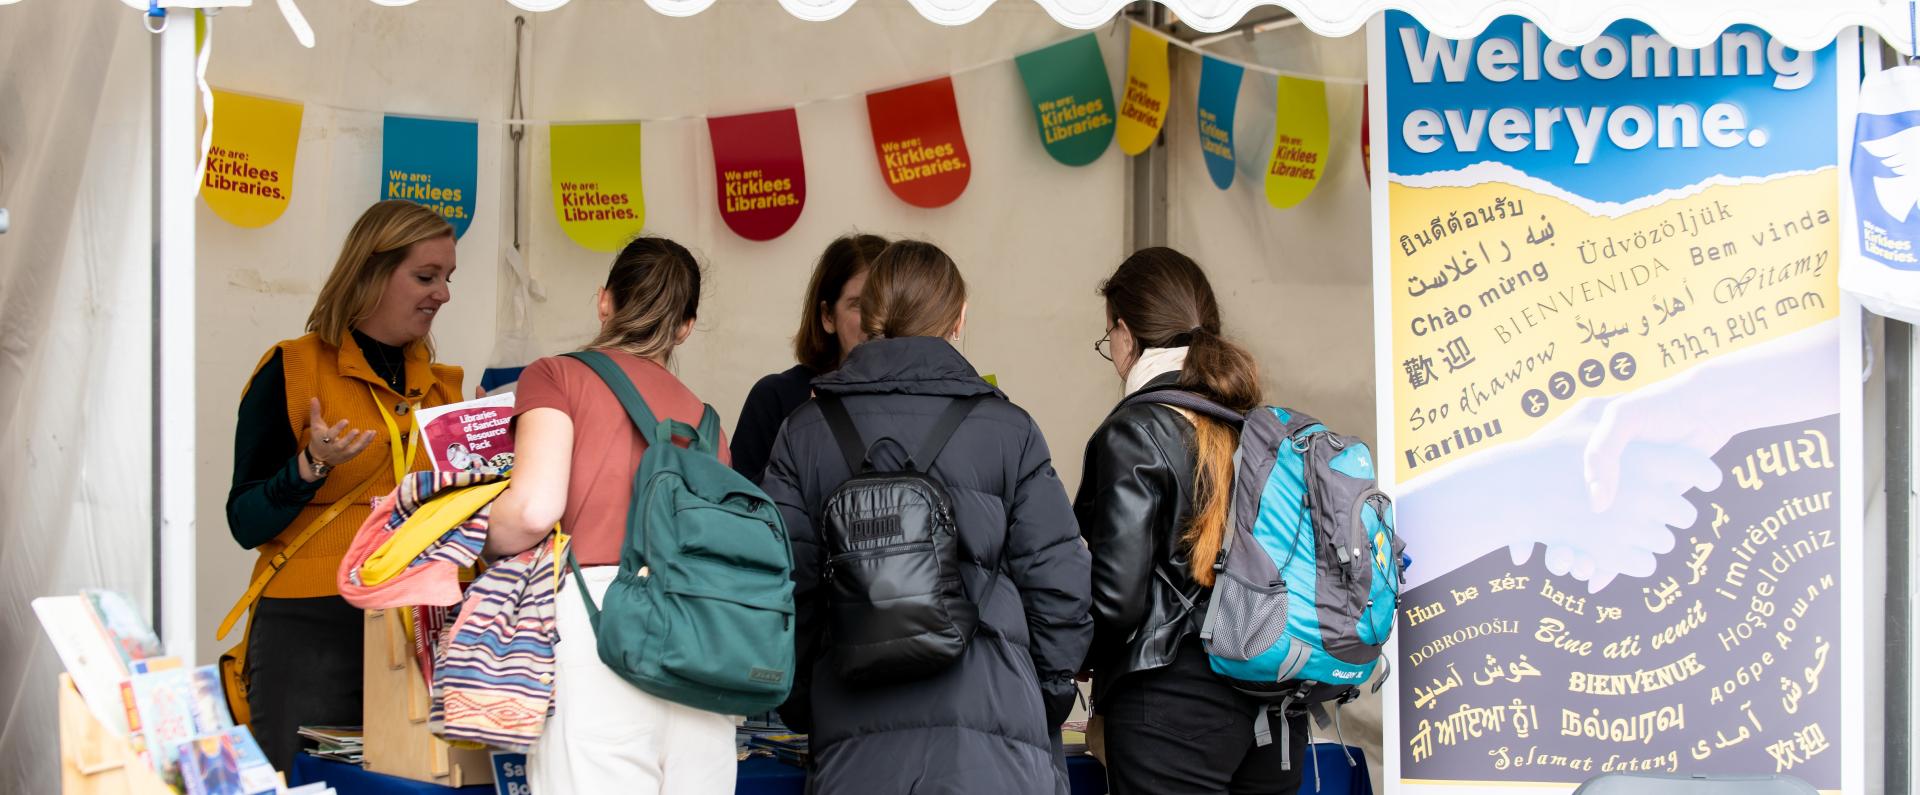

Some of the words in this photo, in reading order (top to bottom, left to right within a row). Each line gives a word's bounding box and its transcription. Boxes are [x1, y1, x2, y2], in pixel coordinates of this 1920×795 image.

[1126, 86, 1161, 112] Kirklees
[1042, 98, 1103, 128] Kirklees
[1045, 113, 1112, 144] Libraries.
[1402, 102, 1768, 164] everyone.
[209, 145, 226, 156] We
[228, 150, 249, 161] are:
[881, 141, 899, 153] We
[901, 138, 921, 149] are:
[884, 143, 954, 169] Kirklees
[1275, 145, 1318, 164] Kirklees
[207, 156, 279, 182] Kirklees
[389, 169, 407, 181] We
[410, 173, 432, 182] are:
[725, 170, 741, 181] We
[743, 170, 762, 179] are:
[889, 158, 967, 184] Libraries.
[1271, 161, 1316, 180] Libraries.
[205, 173, 285, 200] Libraries.
[388, 181, 462, 201] Kirklees
[561, 182, 577, 191] We
[562, 192, 628, 206] Kirklees
[725, 179, 792, 197] Kirklees
[564, 206, 639, 222] Libraries.
[727, 192, 799, 213] Libraries.
[1400, 196, 1524, 257] ยินดีต้อนรับ
[1577, 201, 1733, 265] Üdvözöljük
[1690, 241, 1737, 266] Bem
[1752, 208, 1830, 246] vinda
[1713, 250, 1828, 304] Witamy
[1411, 304, 1472, 337] Chào
[1478, 261, 1549, 307] mừng
[1494, 257, 1670, 344] BIENVENIDA
[1402, 336, 1476, 390] 歡迎
[1409, 402, 1449, 431] Soo
[1460, 341, 1555, 415] dhawow
[1523, 353, 1634, 416] ようこそ
[459, 411, 497, 424] Libraries
[463, 424, 473, 433] of
[472, 416, 511, 432] Sanctuar
[466, 427, 507, 442] Resource
[469, 440, 491, 451] Pack
[1405, 418, 1502, 469] Karibu
[1406, 601, 1446, 627] Hun
[1451, 586, 1479, 606] be
[1596, 605, 1622, 623] ye
[1409, 617, 1520, 667] DOBRODOŠLI
[1534, 617, 1593, 656] Bine
[1603, 635, 1641, 659] ati
[1651, 599, 1707, 650] venit
[1710, 652, 1774, 705] добре
[1775, 574, 1834, 650] дошли
[1473, 654, 1542, 686] خوش
[1568, 652, 1706, 695] BIENVENUE
[1410, 719, 1432, 763] ਜੀ
[1765, 722, 1830, 773] 欢迎
[503, 762, 524, 778] Sa
[1488, 745, 1593, 771] Selamat
[1601, 750, 1678, 773] datang
[507, 782, 530, 795] Bo
